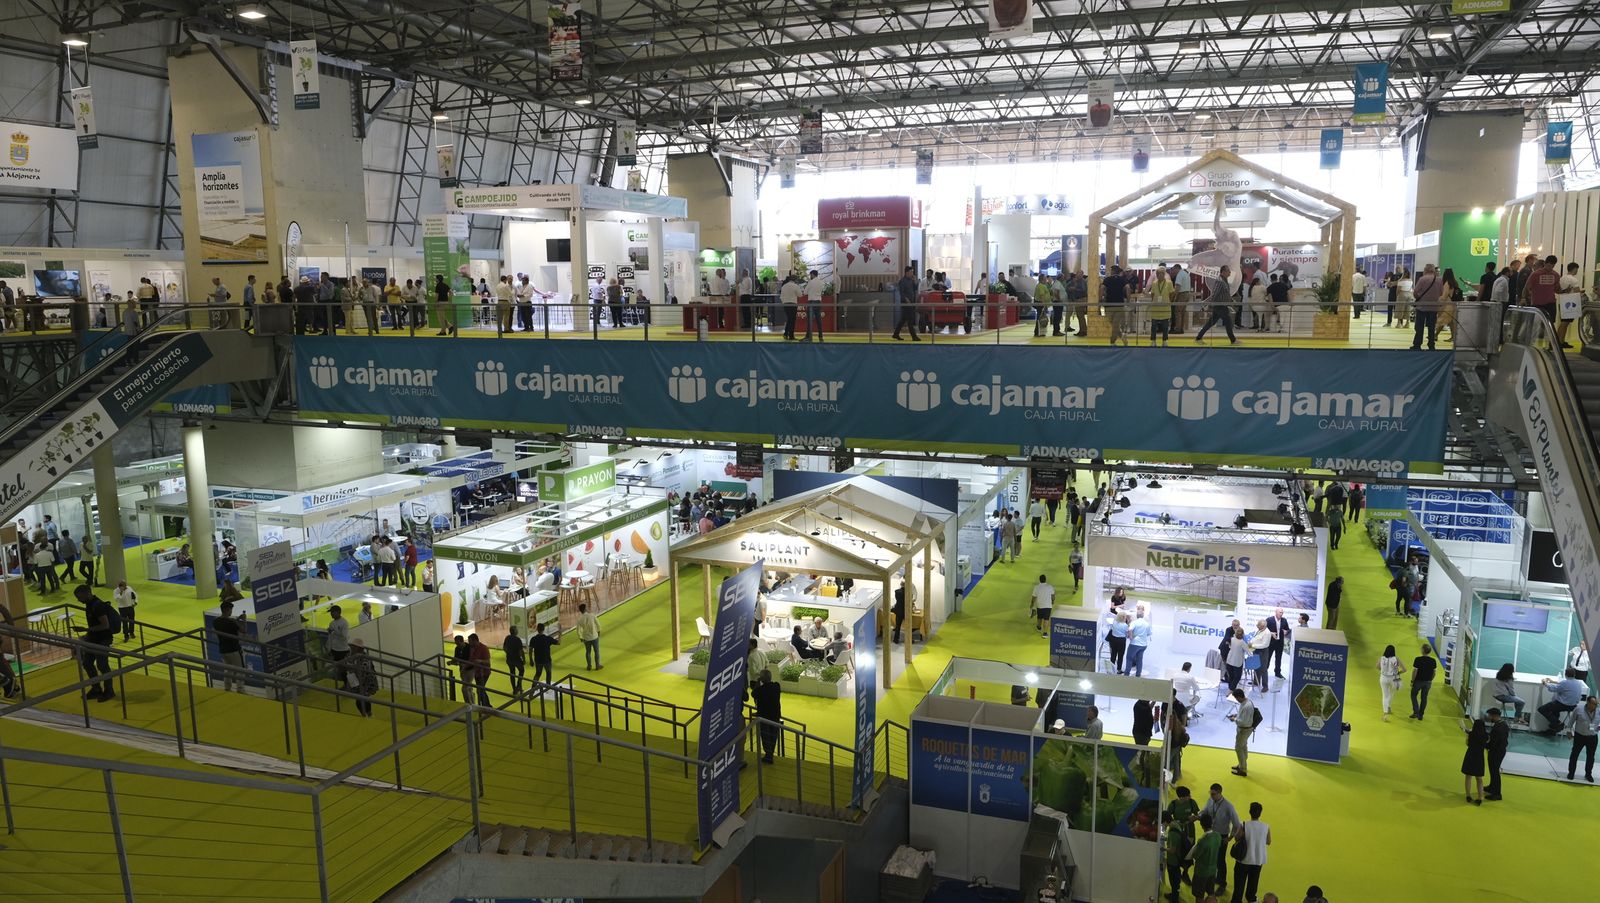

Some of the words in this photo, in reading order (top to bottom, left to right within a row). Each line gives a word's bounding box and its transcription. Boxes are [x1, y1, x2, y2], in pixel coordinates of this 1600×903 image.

[1462, 1, 1503, 9] ADNAGRO
[6, 172, 41, 180] Mojonera
[202, 172, 226, 184] Amplia
[1208, 171, 1233, 180] Grupo
[203, 182, 239, 191] horizontes
[1208, 178, 1250, 188] Tecniagro
[464, 194, 517, 203] CAMPOEJIDO
[1224, 198, 1247, 206] niagro
[832, 210, 849, 219] royal
[851, 210, 886, 218] brinkman
[1244, 256, 1260, 264] ora
[1278, 255, 1318, 263] siempre
[1196, 264, 1220, 276] Durat
[113, 388, 124, 402] El
[124, 370, 152, 394] mejor
[152, 347, 182, 375] injerto
[344, 360, 438, 392] cajamar
[121, 392, 144, 412] para
[143, 382, 154, 394] tu
[154, 354, 190, 384] cosecha
[515, 364, 624, 399] cajamar
[390, 386, 410, 395] CAJA
[412, 387, 438, 397] RURAL
[715, 370, 844, 407] cajamar
[568, 394, 591, 403] CAJA
[593, 395, 623, 404] RURAL
[952, 375, 1105, 415] cajamar
[178, 403, 214, 413] ADNAGRO
[777, 401, 804, 412] CAJA
[807, 402, 842, 413] RURAL
[1232, 381, 1416, 426] cajamar
[396, 416, 438, 426] ADNAGRO
[1024, 409, 1057, 420] CAJA
[1060, 410, 1100, 422] RURAL
[575, 425, 624, 436] ADNAGRO
[1318, 418, 1355, 430] CAJA
[1360, 420, 1408, 432] RURAL
[784, 434, 842, 447] ADNAGRO
[1031, 445, 1099, 460] ADNAGRO
[1528, 398, 1541, 430] El
[1537, 419, 1566, 504] Plantel
[1324, 457, 1404, 473] ADNAGRO
[578, 468, 612, 489] PRAYON
[632, 509, 648, 520] PRAYON
[816, 527, 878, 537] SALIPLNT
[557, 535, 580, 549] PRAYON
[740, 541, 810, 556] SALIPLANT
[259, 551, 273, 560] SER
[464, 551, 498, 562] PRAYON
[1146, 552, 1250, 573] NaturPláS
[255, 578, 294, 602] SER
[722, 580, 745, 612] SE
[267, 613, 282, 622] SER
[1054, 626, 1093, 637] NaturPláS
[1179, 624, 1225, 637] NaturPlá
[1060, 642, 1086, 650] Solmax
[1055, 648, 1091, 656] solarización
[1298, 651, 1343, 662] NaturPláS
[1304, 667, 1335, 676] Thermo
[707, 657, 744, 700] SER
[1302, 673, 1320, 681] Max
[1322, 675, 1335, 683] AG
[983, 746, 997, 761] DE
[1001, 748, 1027, 766] MAR
[934, 754, 942, 762] A
[944, 755, 952, 763] la
[953, 756, 995, 770] vanguardia
[996, 762, 1005, 771] de
